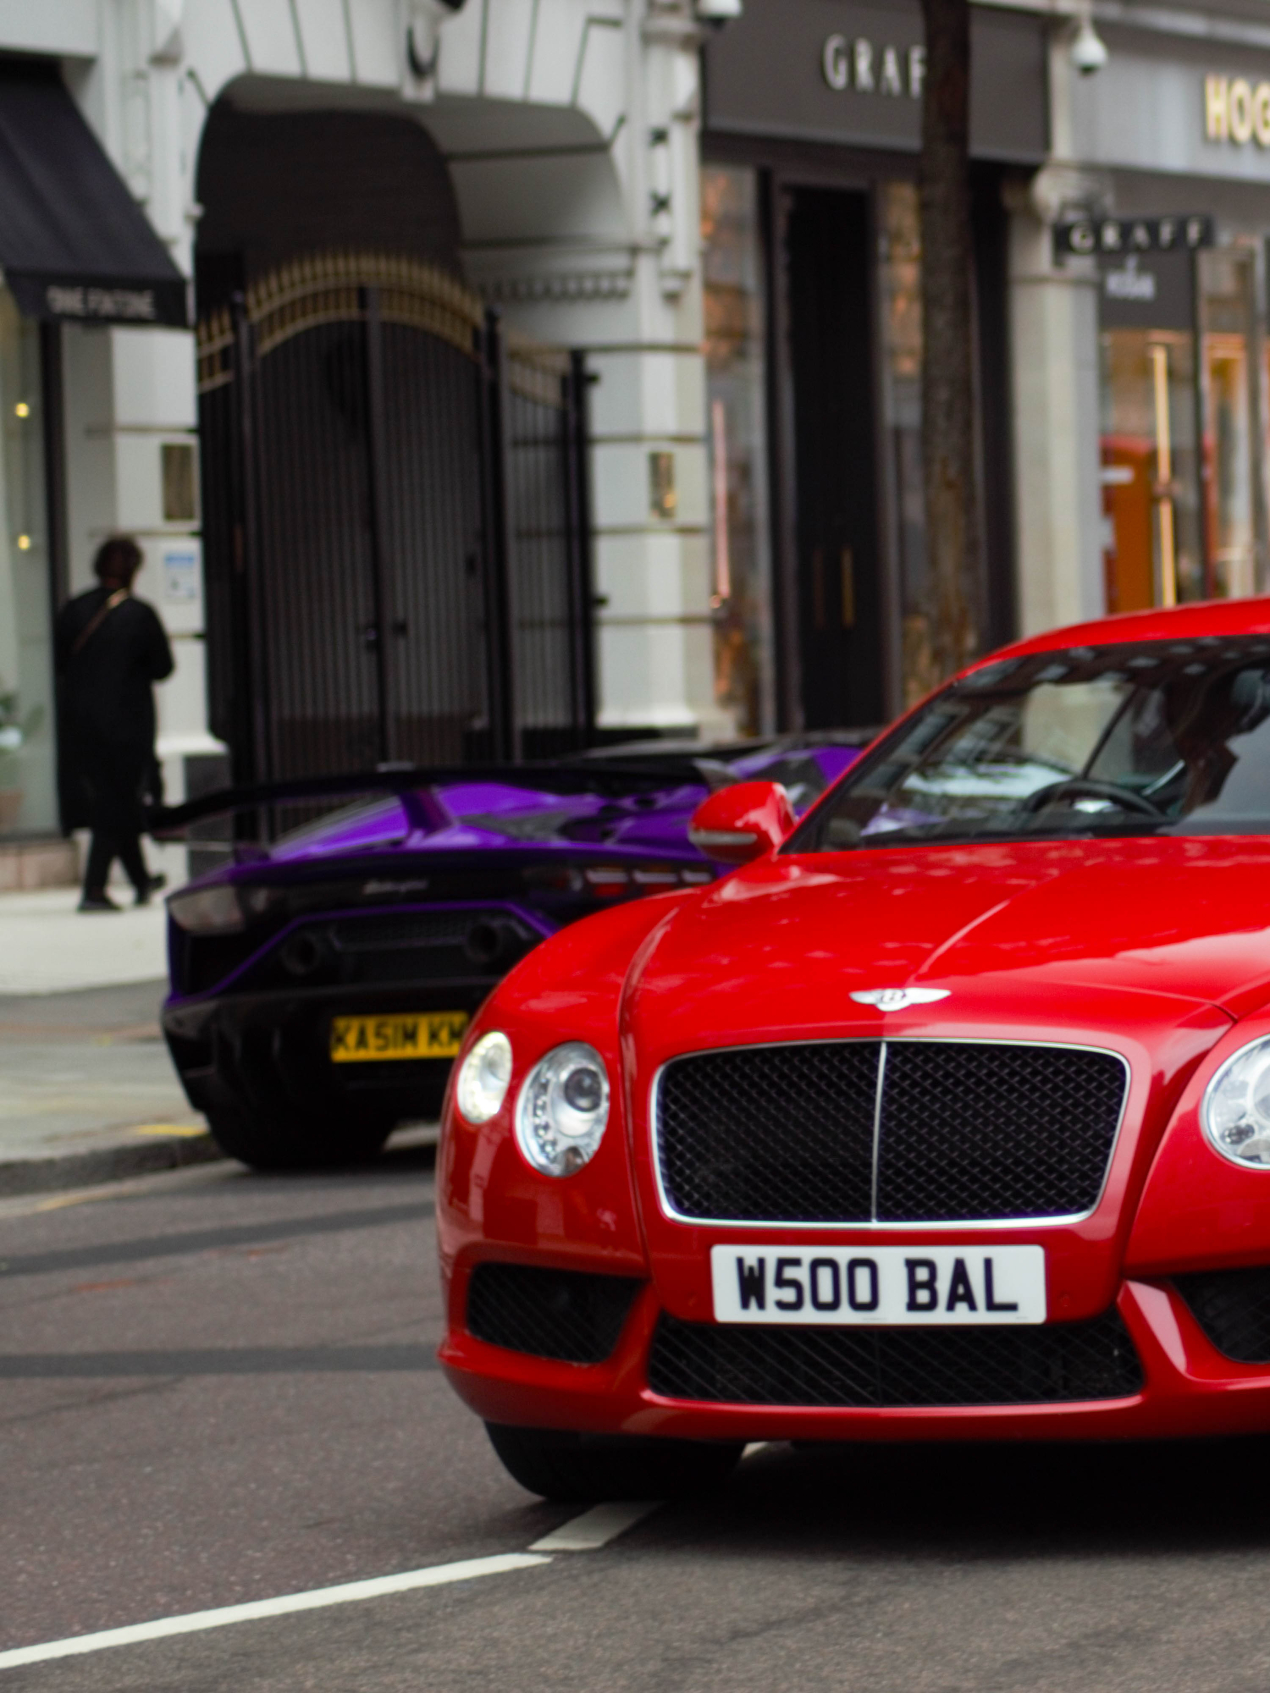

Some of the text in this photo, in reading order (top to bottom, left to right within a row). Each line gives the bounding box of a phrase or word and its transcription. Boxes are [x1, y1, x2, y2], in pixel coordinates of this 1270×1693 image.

[1070, 217, 1202, 252] GRAFF
[736, 1257, 1019, 1312] W500 BAL
